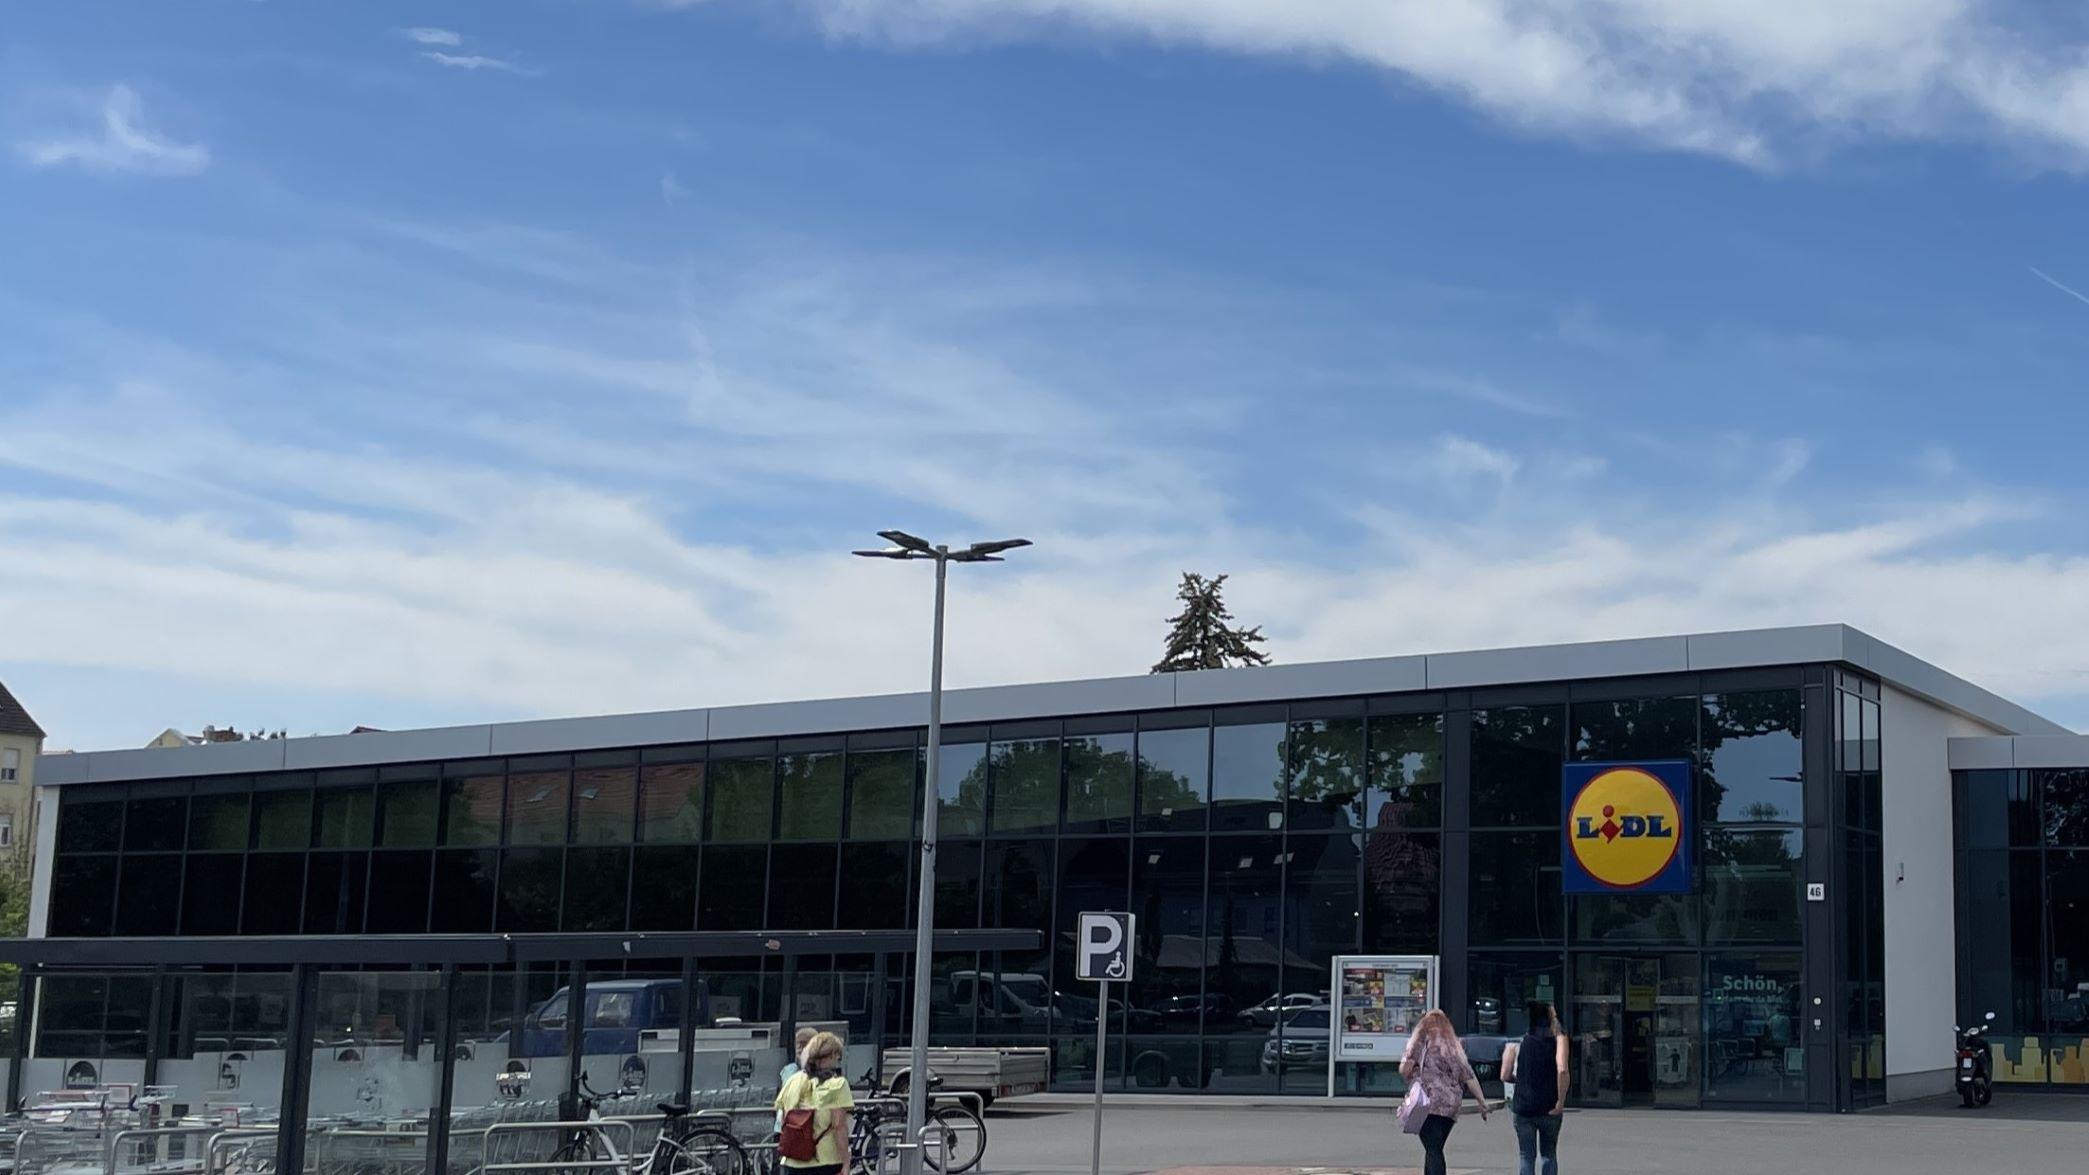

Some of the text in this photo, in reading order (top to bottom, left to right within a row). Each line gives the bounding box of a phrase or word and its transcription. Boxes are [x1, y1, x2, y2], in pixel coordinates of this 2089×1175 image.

[1810, 886, 1822, 897] 46
[1080, 915, 1122, 977] P
[1723, 975, 1784, 994] Schön,
